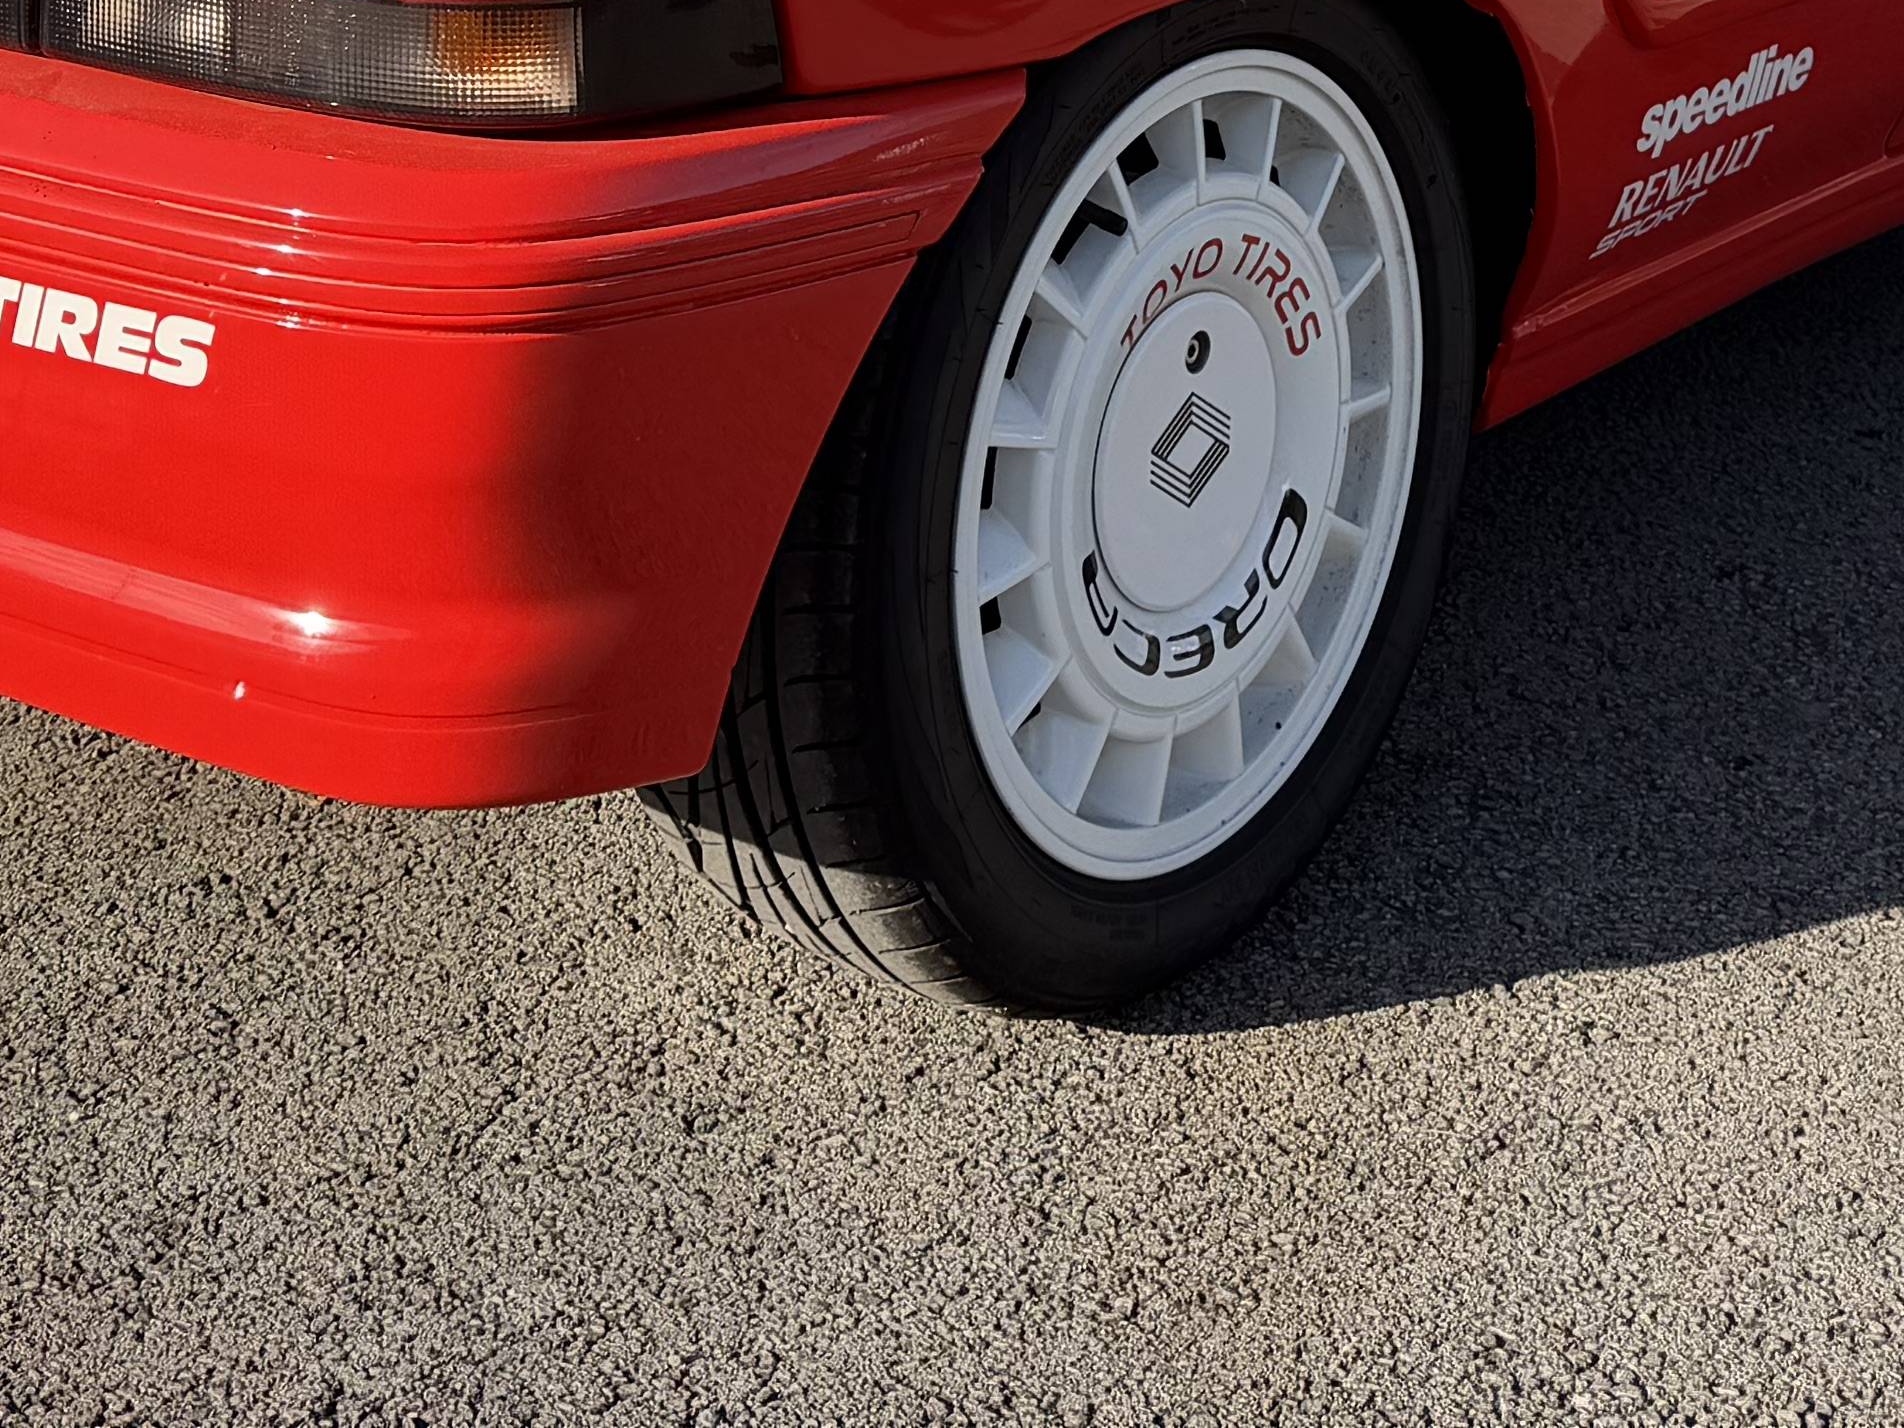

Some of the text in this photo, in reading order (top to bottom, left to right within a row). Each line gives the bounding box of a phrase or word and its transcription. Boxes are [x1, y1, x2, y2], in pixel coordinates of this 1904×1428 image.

[1636, 44, 1814, 159] speedline
[1588, 190, 1708, 260] SPORT
[1607, 125, 1775, 229] RENAULT
[1119, 232, 1323, 358] TOYO TIRES
[1081, 487, 1309, 679] ORECA
